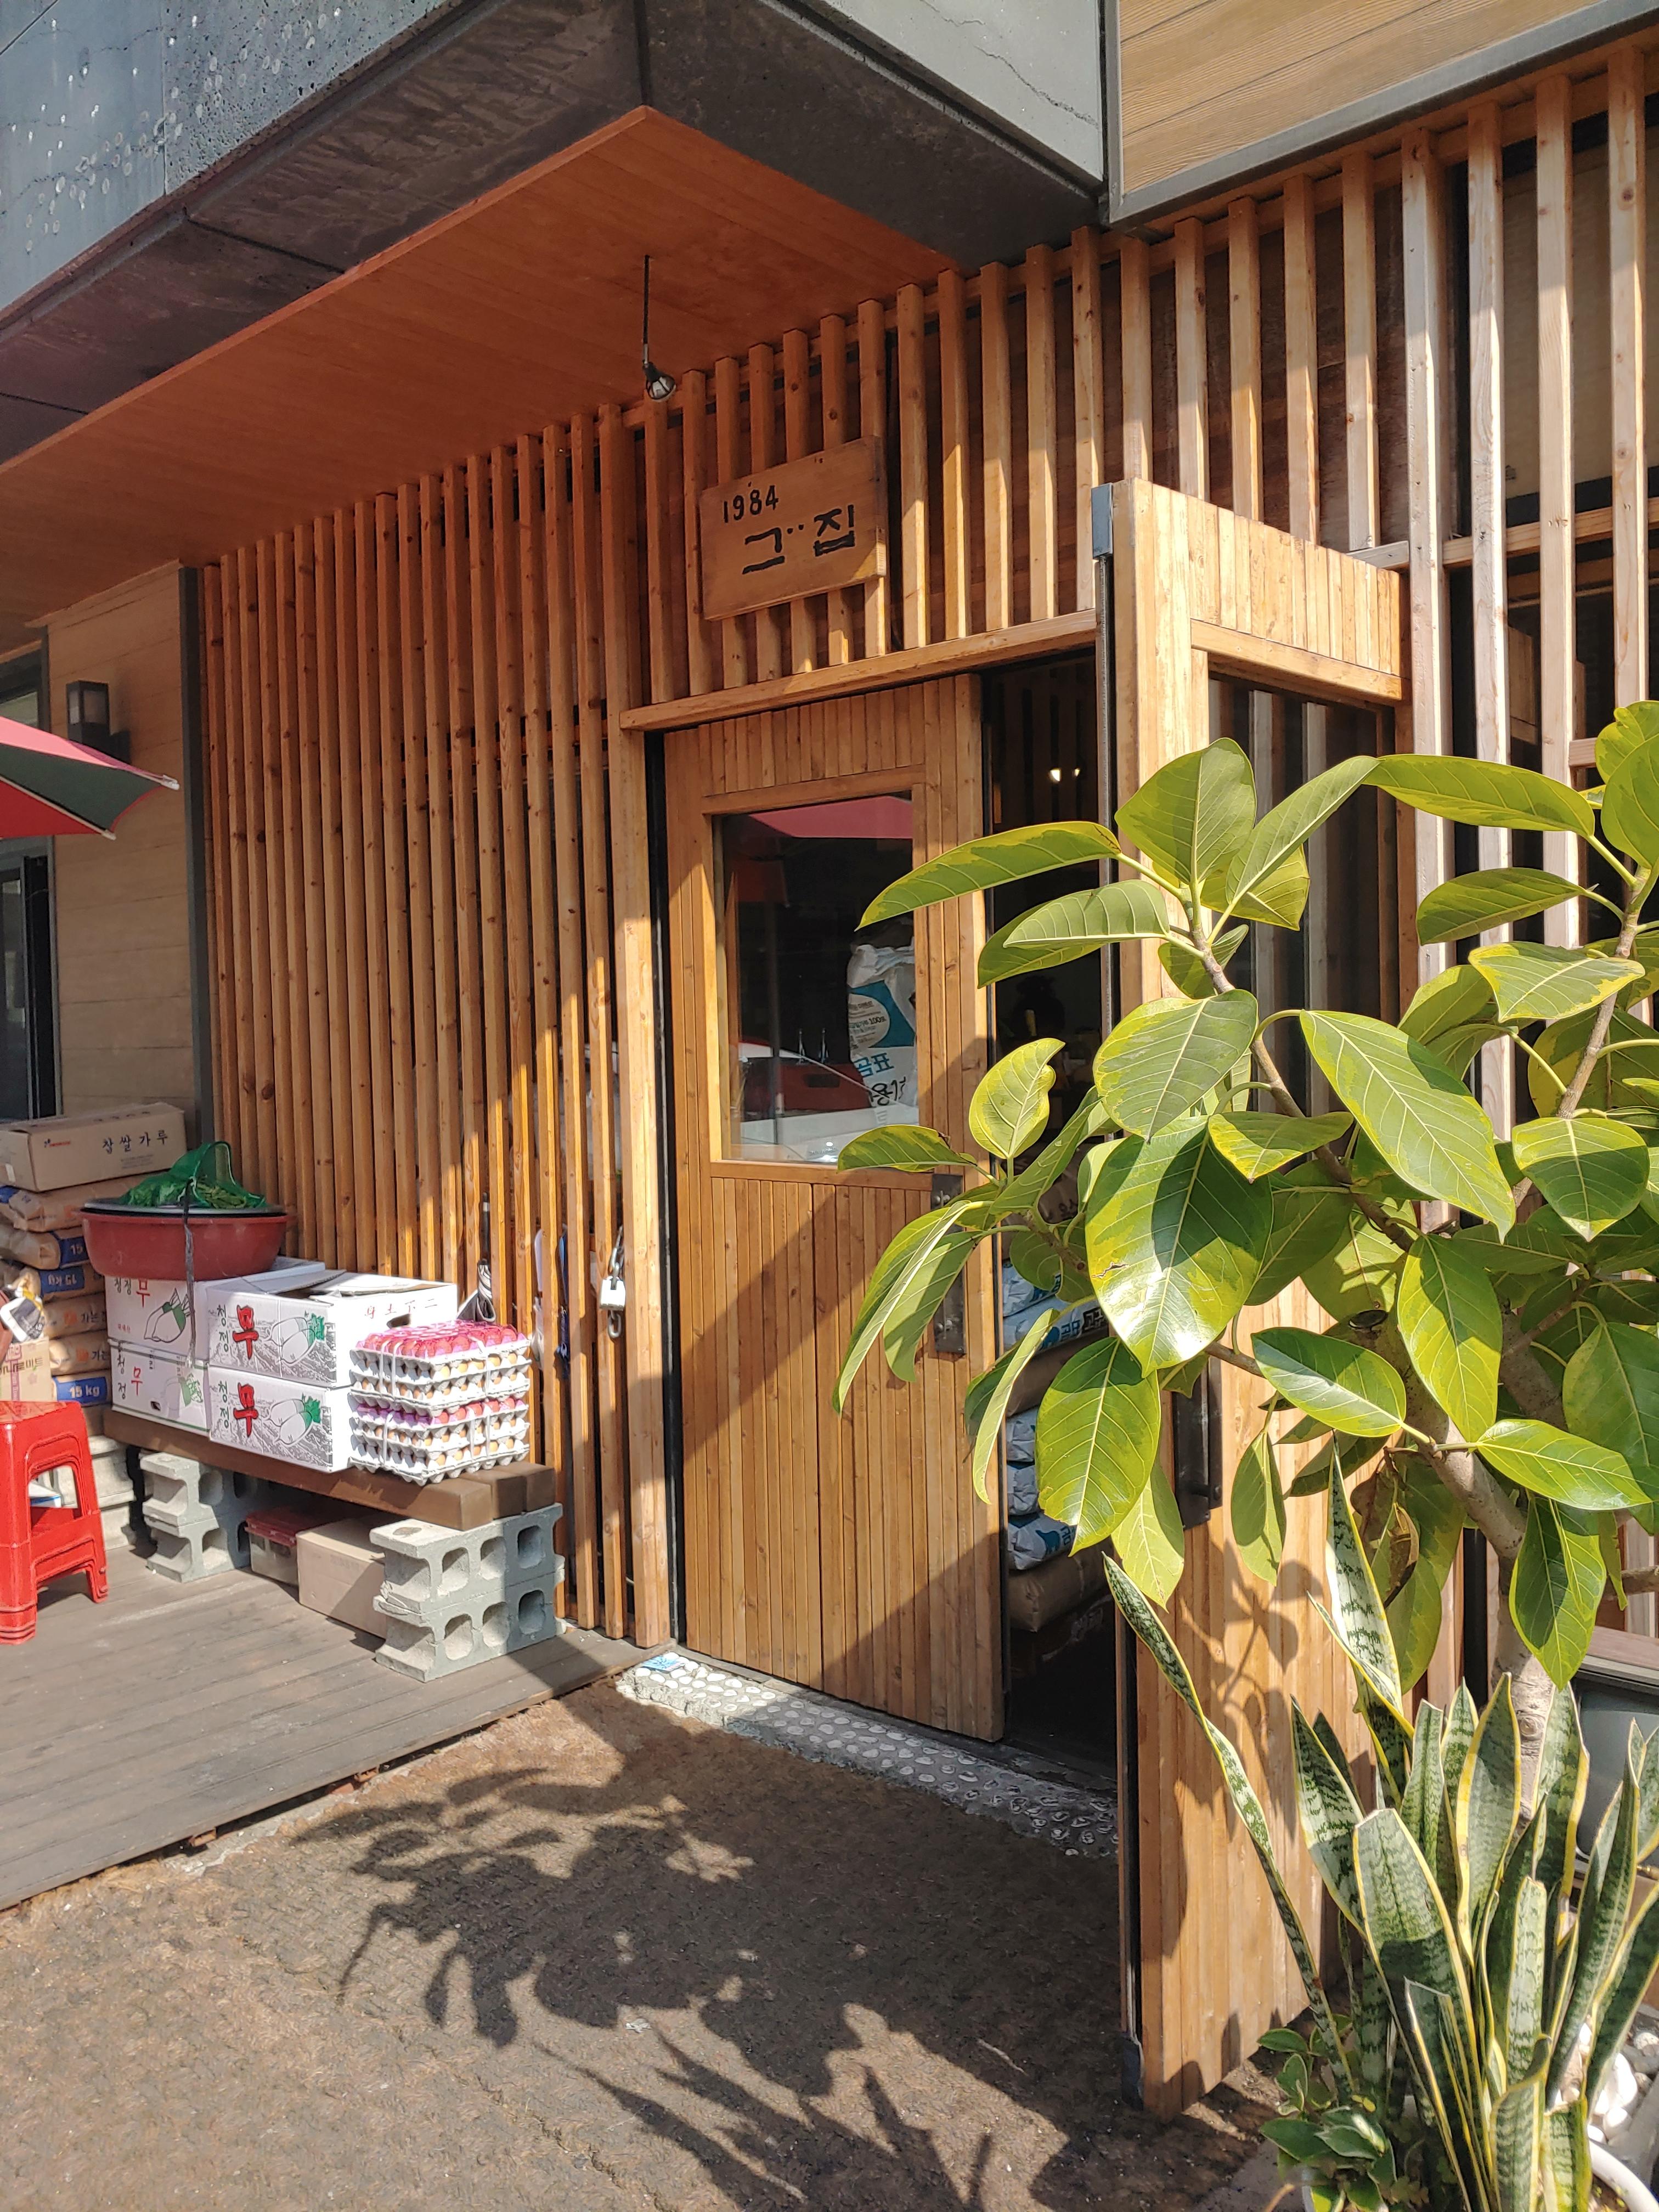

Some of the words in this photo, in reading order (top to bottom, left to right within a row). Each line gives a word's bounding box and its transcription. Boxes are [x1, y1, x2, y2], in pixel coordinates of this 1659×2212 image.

[724, 485, 779, 523] 1984
[103, 1130, 168, 1154] 찹쌀가루
[233, 1305, 259, 1359] 무
[70, 1386, 82, 1398] 15
[86, 1385, 100, 1397] kg
[131, 1366, 143, 1396] 무
[218, 1380, 229, 1428] 청정
[233, 1382, 258, 1437] 무
